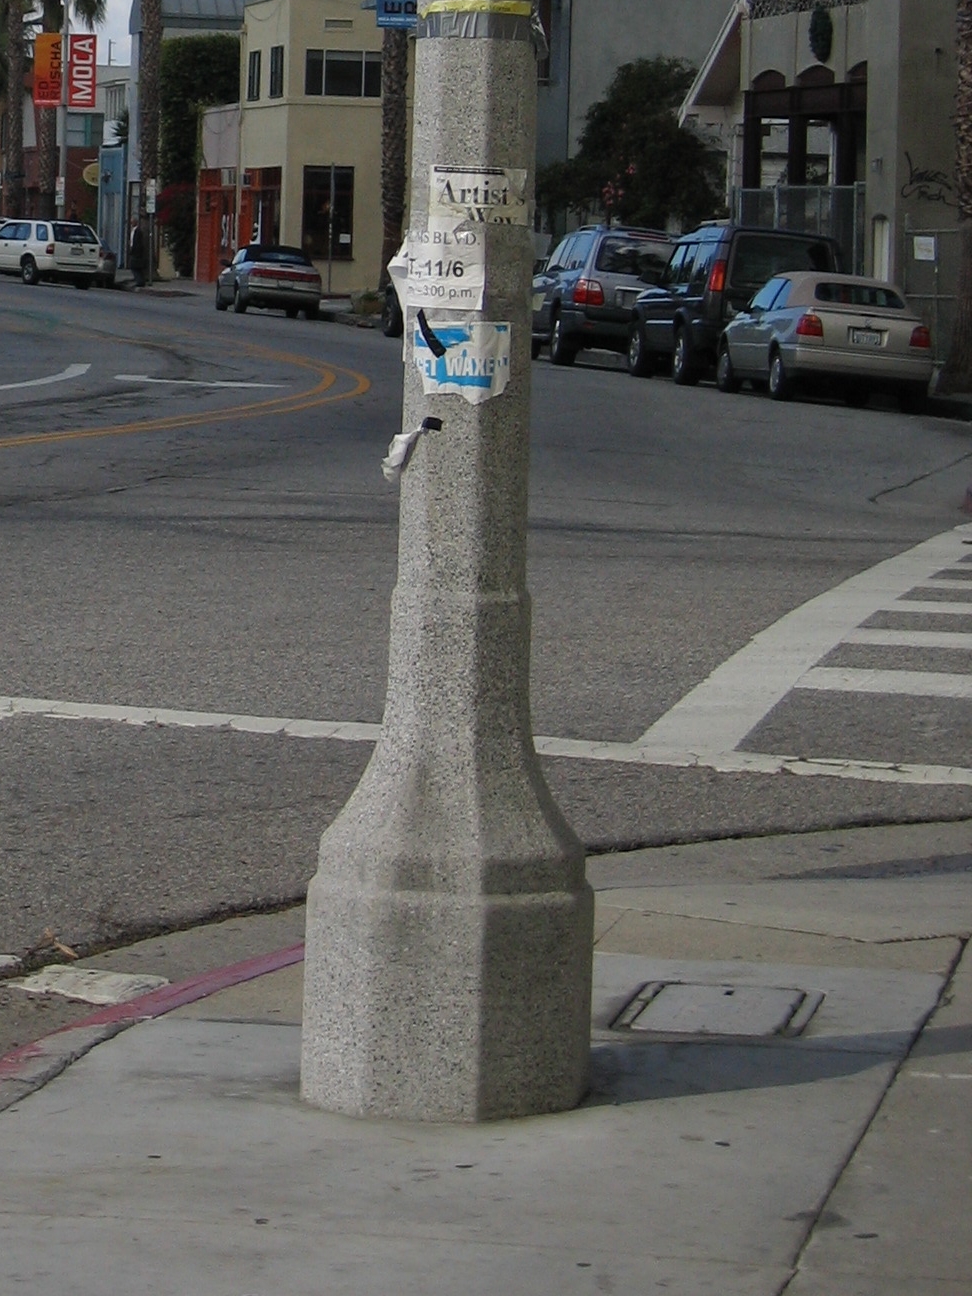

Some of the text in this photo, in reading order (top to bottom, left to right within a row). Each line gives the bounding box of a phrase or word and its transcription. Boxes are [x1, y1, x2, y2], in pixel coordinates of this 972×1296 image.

[50, 41, 61, 100] RUSCHA
[438, 179, 525, 206] Artists
[424, 259, 464, 278] 11/6
[449, 288, 476, 299] p.m.
[445, 356, 503, 376] WAXE
